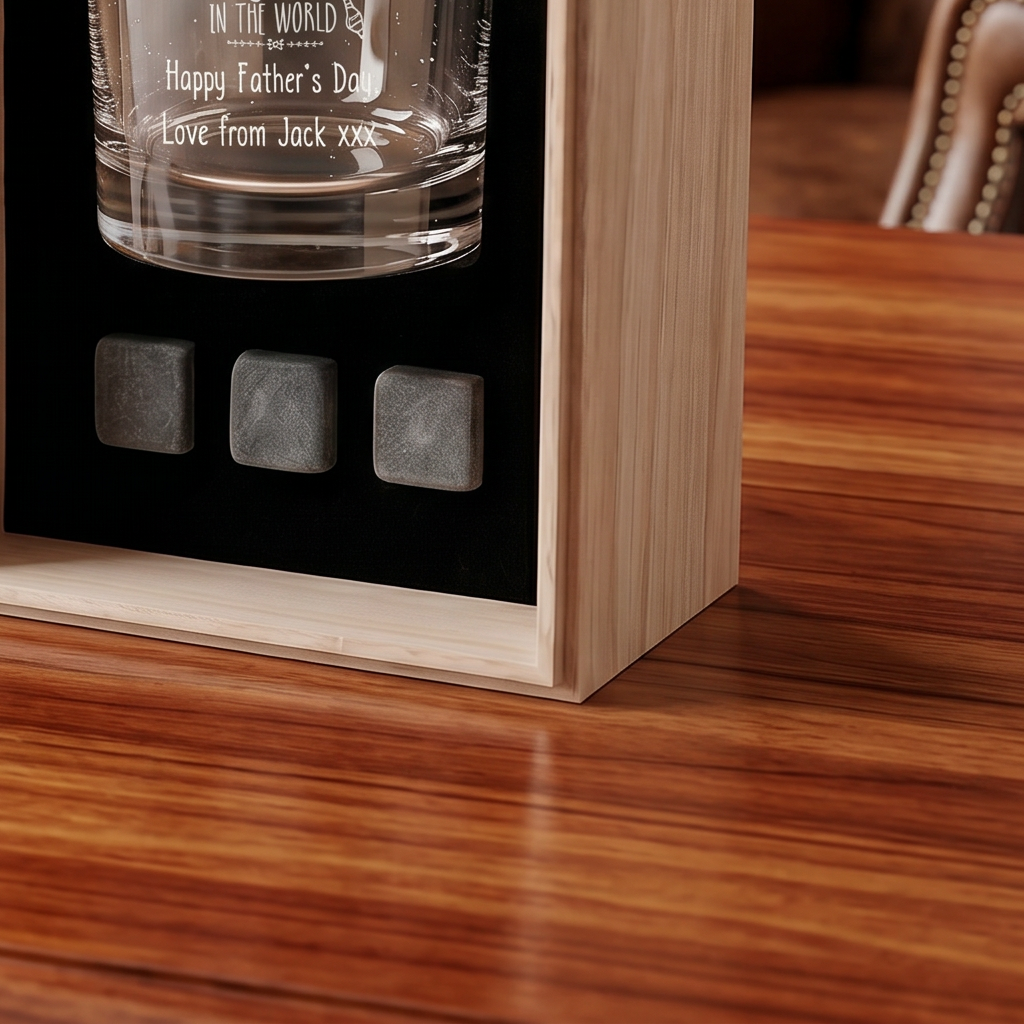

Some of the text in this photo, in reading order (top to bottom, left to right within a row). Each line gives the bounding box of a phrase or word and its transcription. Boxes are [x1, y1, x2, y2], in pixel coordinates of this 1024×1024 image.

[209, 1, 337, 36] IN THE WORLD
[166, 59, 372, 101] Happy Father's Day
[162, 112, 377, 147] Love from Jack xxx
